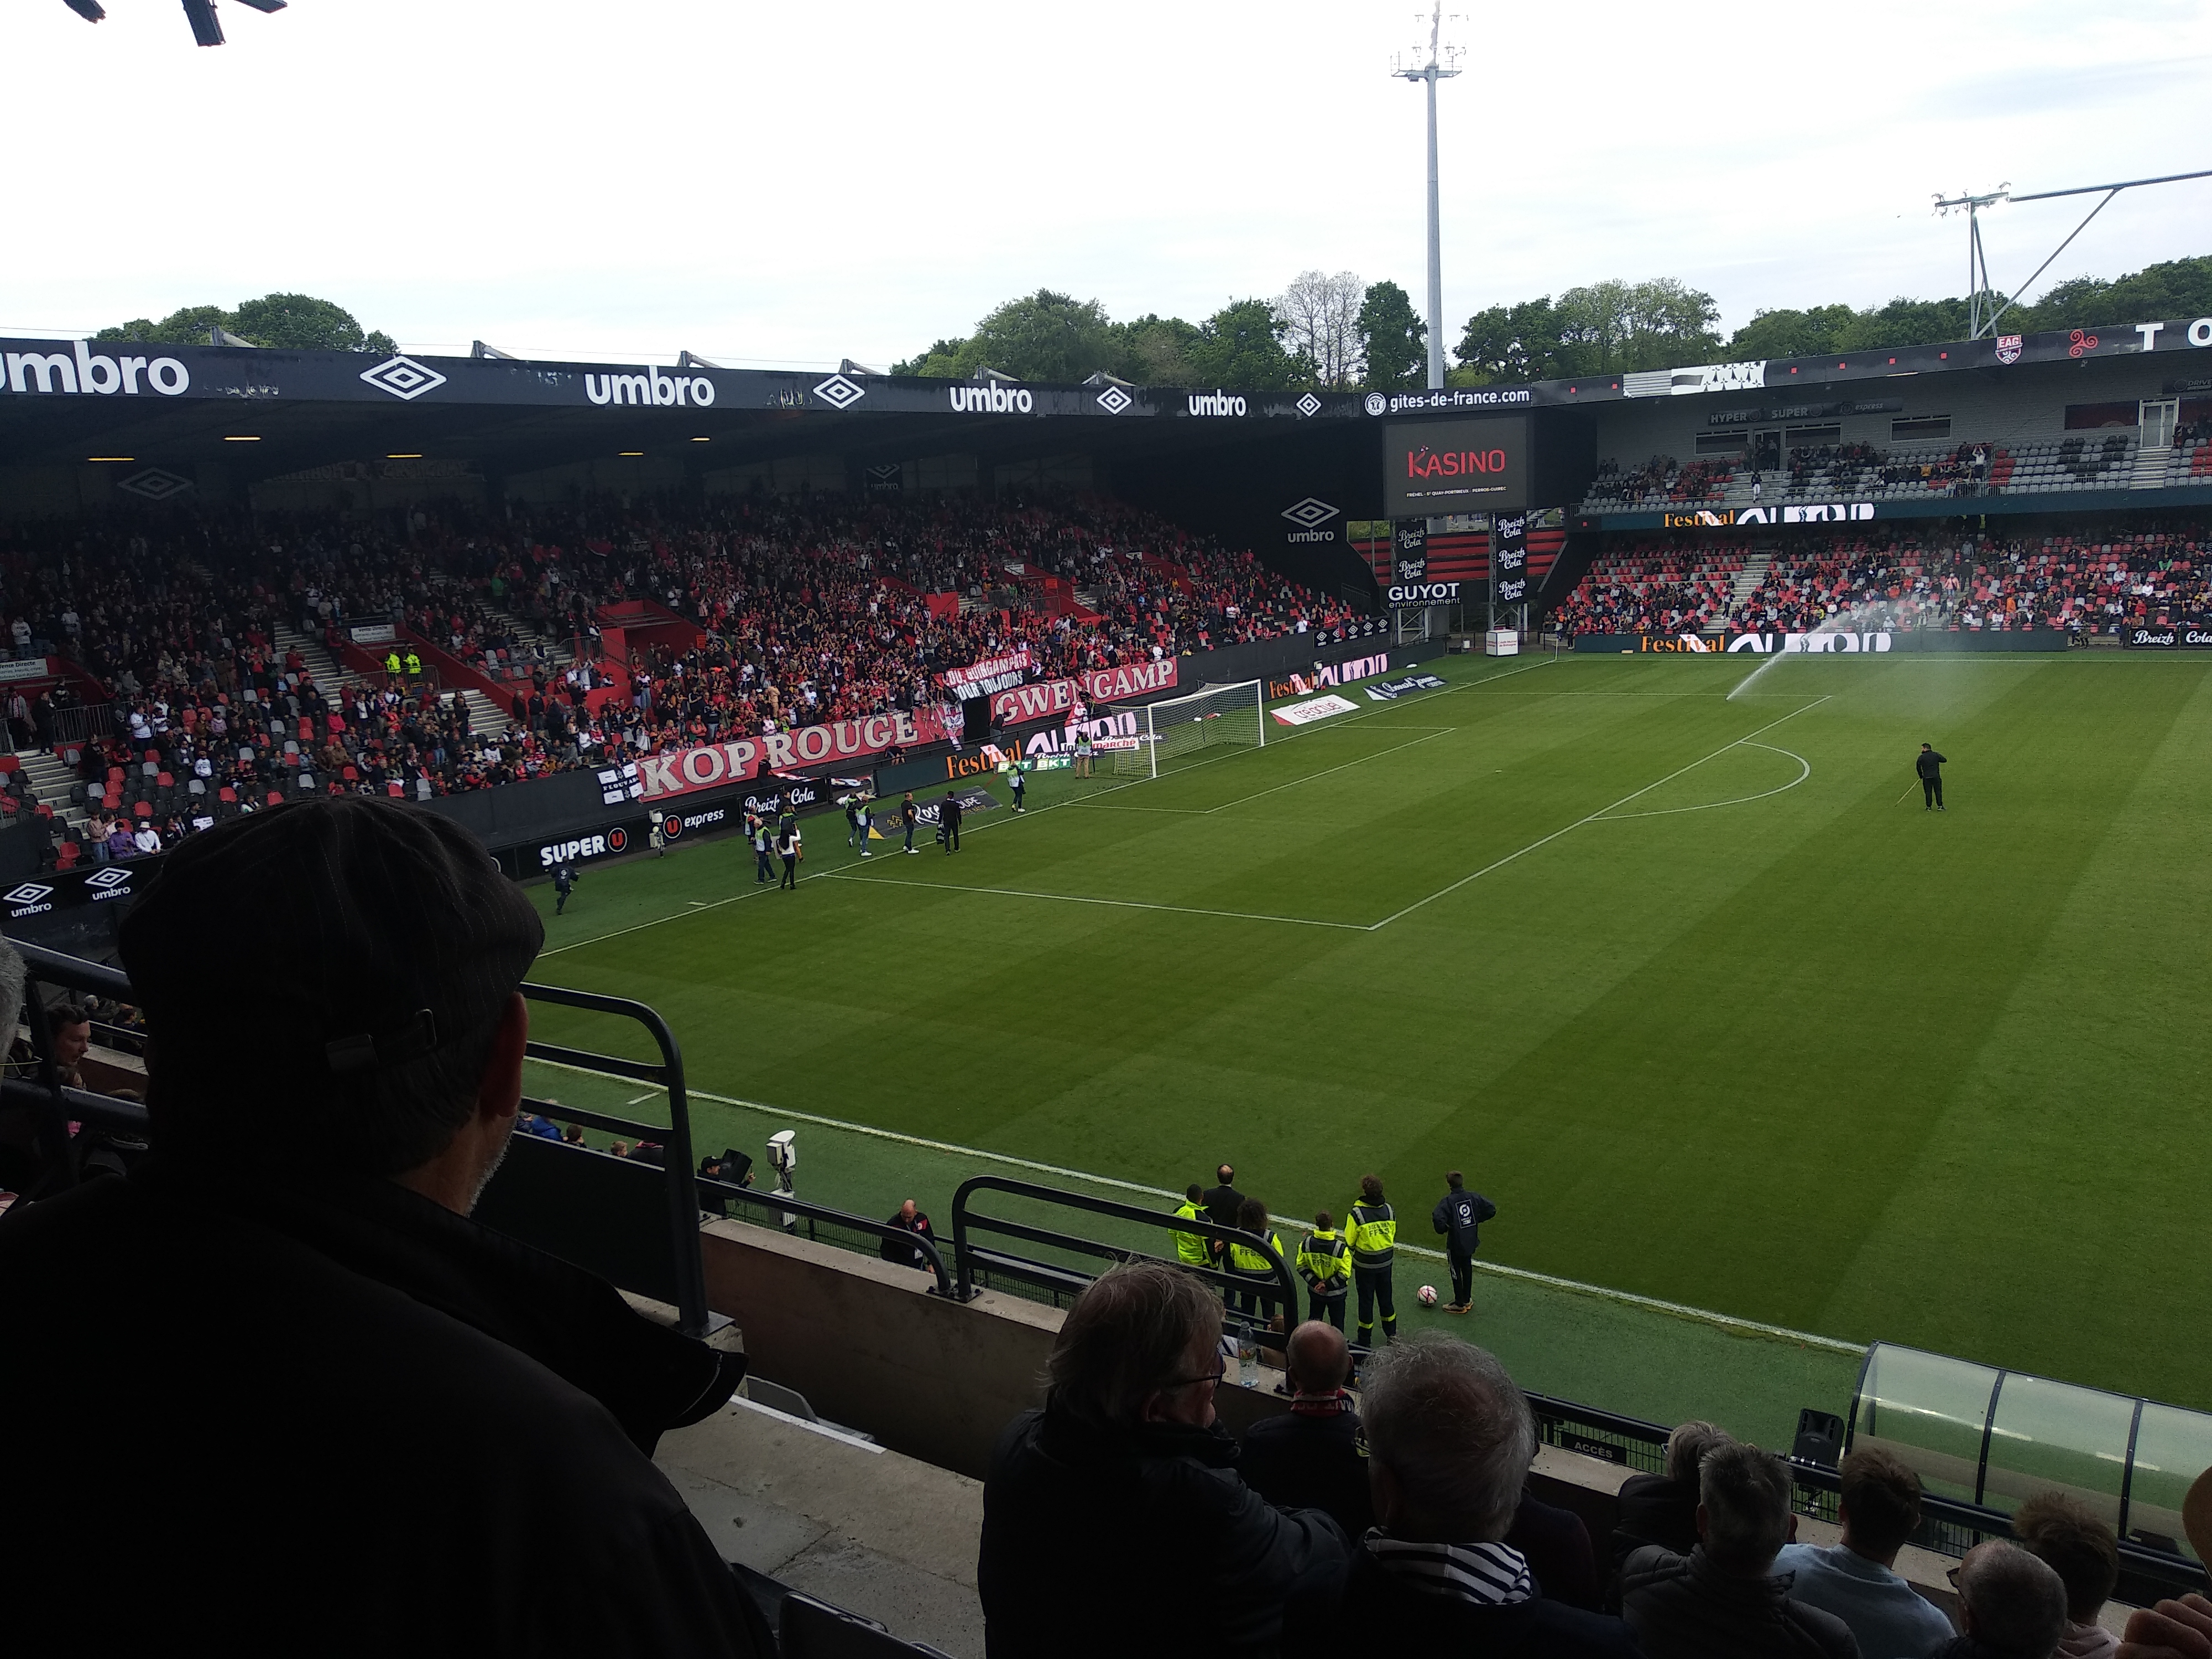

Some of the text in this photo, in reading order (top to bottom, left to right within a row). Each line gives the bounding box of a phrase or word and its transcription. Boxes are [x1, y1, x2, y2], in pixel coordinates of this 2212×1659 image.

[1998, 337, 2020, 351] EAG
[0, 341, 189, 395] mbro
[586, 366, 714, 406] umbro
[950, 380, 1032, 413] umbro
[1188, 389, 1246, 416] umbro
[1390, 390, 1529, 413] gites-de-france.com
[1771, 407, 1808, 419] SUPER
[1855, 403, 1884, 411] express
[1711, 413, 1747, 424] HYPER
[1408, 446, 1505, 479] KASINO
[1498, 516, 1525, 532] Breizh
[1664, 509, 1734, 527] Festival
[1287, 528, 1334, 543] umbro
[1398, 527, 1425, 542] Breizh
[1504, 528, 1521, 539] Cola
[1404, 538, 1422, 549] Cola
[1498, 547, 1525, 562] Breizh
[1399, 557, 1426, 573] Breizh
[1504, 559, 1522, 570] Cola
[1405, 570, 1422, 580] Cola
[1388, 582, 1460, 601] GUYOT
[1499, 578, 1526, 594] Breizh
[1389, 597, 1460, 608] environnement
[1505, 589, 1522, 601] Cola
[1641, 634, 1724, 653] Festival
[2132, 630, 2212, 645] Breizh Cola
[966, 653, 1027, 681] GUINGAMPAIS
[980, 670, 1023, 695] TOUJOURS
[1269, 671, 1315, 699] Festival
[995, 660, 1173, 722] GWENGAMP
[640, 712, 919, 797] KOP ROUGE
[946, 739, 1023, 779] Festival
[1039, 758, 1070, 769] BKT
[791, 787, 816, 805] Cola
[667, 809, 724, 834] U express
[541, 832, 623, 865] SUPER U
[92, 886, 131, 901] umbro
[11, 902, 52, 917] umbro
[1574, 1441, 1613, 1458] ACCÈS
